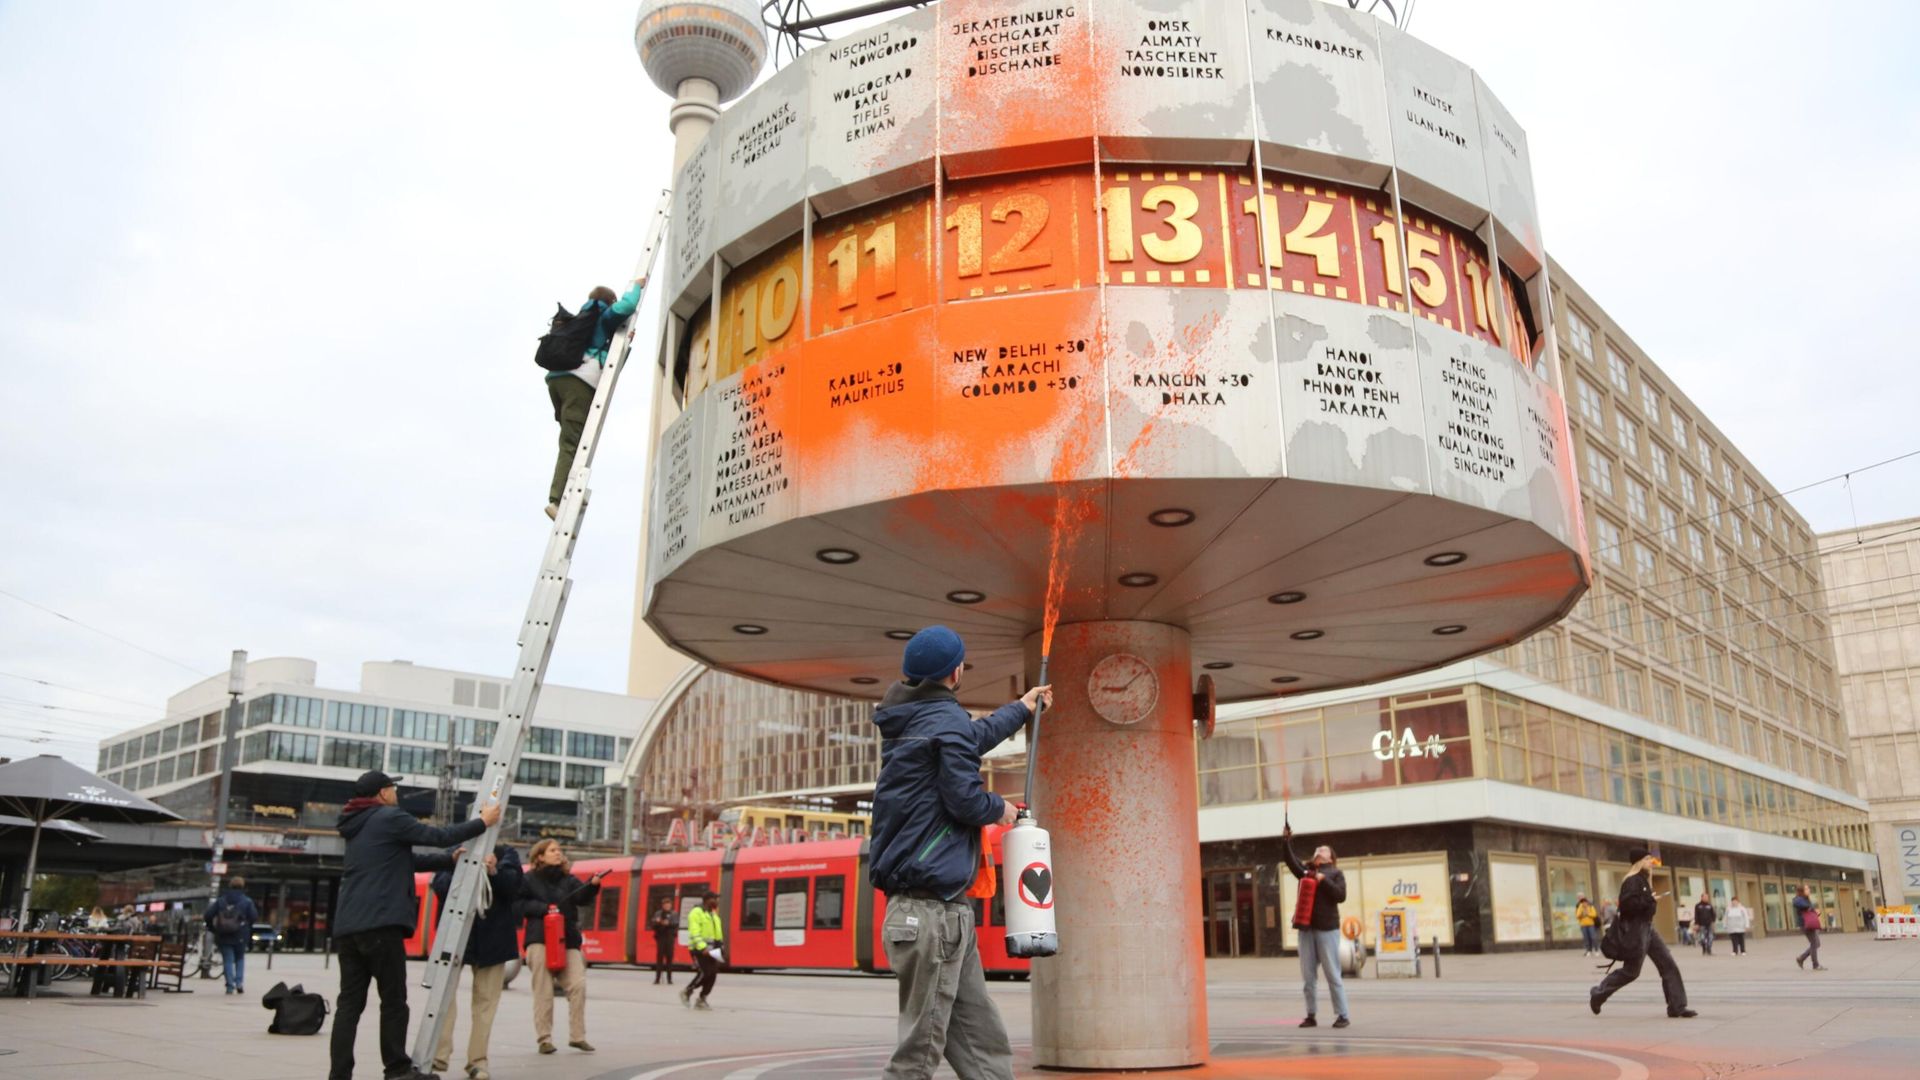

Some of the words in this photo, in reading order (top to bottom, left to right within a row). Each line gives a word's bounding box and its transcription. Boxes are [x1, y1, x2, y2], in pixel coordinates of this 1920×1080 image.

[953, 7, 1075, 35] JEKATERINBURG
[1148, 20, 1191, 32] OMSK
[829, 32, 889, 62] NISCHNIJ
[969, 24, 1060, 47] ASCHGABAT
[1140, 35, 1202, 47] ALMATY
[1266, 28, 1364, 61] KRASNOJARSK
[850, 37, 917, 69] NOWGOROD
[977, 41, 1051, 61] BISCHKEK
[1126, 50, 1218, 64] TASCHKENT
[968, 54, 1061, 77] DUSCHANBE
[1121, 65, 1224, 80] NOWOSIBIRSK
[834, 68, 912, 102] WOLGOGRAD
[855, 90, 888, 110] BAKU
[1413, 86, 1454, 116] IRKUTSK
[738, 102, 789, 145] MURMANSK
[853, 104, 890, 125] TIFLIS
[743, 111, 796, 156] PETERSBURG
[846, 117, 896, 142] ERIWAN
[1406, 109, 1468, 149] ULAN-BATOR
[743, 134, 781, 168] MOSKAU
[946, 192, 1051, 279] 12
[1093, 184, 1203, 264] 13
[1243, 193, 1341, 278] 14
[828, 221, 896, 311] 11
[1371, 219, 1448, 308] 15
[738, 265, 799, 355] 10
[953, 348, 988, 364] NEW
[998, 343, 1047, 359] DELHI
[1325, 347, 1372, 366] HANOI
[828, 370, 873, 391] KABUL
[877, 362, 902, 377] +30
[981, 359, 1061, 379] KARACHI
[1133, 373, 1207, 388] RANGUN
[1317, 363, 1384, 385] BANGKOK
[1450, 357, 1486, 380] PEKING
[718, 375, 763, 403] TEHERAN
[732, 385, 772, 412] BAGDAD
[830, 378, 905, 408] MAURITIUS
[961, 379, 1037, 399] COLOMBO
[1303, 378, 1355, 398] PHNOM
[1363, 387, 1400, 404] PENH
[1442, 370, 1497, 400] SHANGHAI
[1162, 392, 1226, 406] DHAKA
[1320, 399, 1388, 421] JAKARTA
[1452, 389, 1493, 415] MANILA
[737, 408, 765, 425] ADEN
[1459, 408, 1490, 429] PERTH
[732, 422, 768, 444] SANAA
[1448, 420, 1504, 450] HONGKONG
[716, 444, 746, 466] ADDIS
[751, 429, 784, 452] ABEBA
[1438, 435, 1474, 457] KUALA
[1477, 447, 1516, 471] LUMPUR
[716, 446, 783, 482] MOGADISCHU
[1454, 457, 1506, 483] SINGAPUR
[715, 462, 782, 498] DARESSALAM
[708, 477, 789, 517] ANTANANARIVO
[728, 502, 766, 526] KUWAIT
[666, 818, 865, 850] ALEXAND
[1900, 829, 1920, 887] MYND
[1392, 879, 1418, 896] dm
